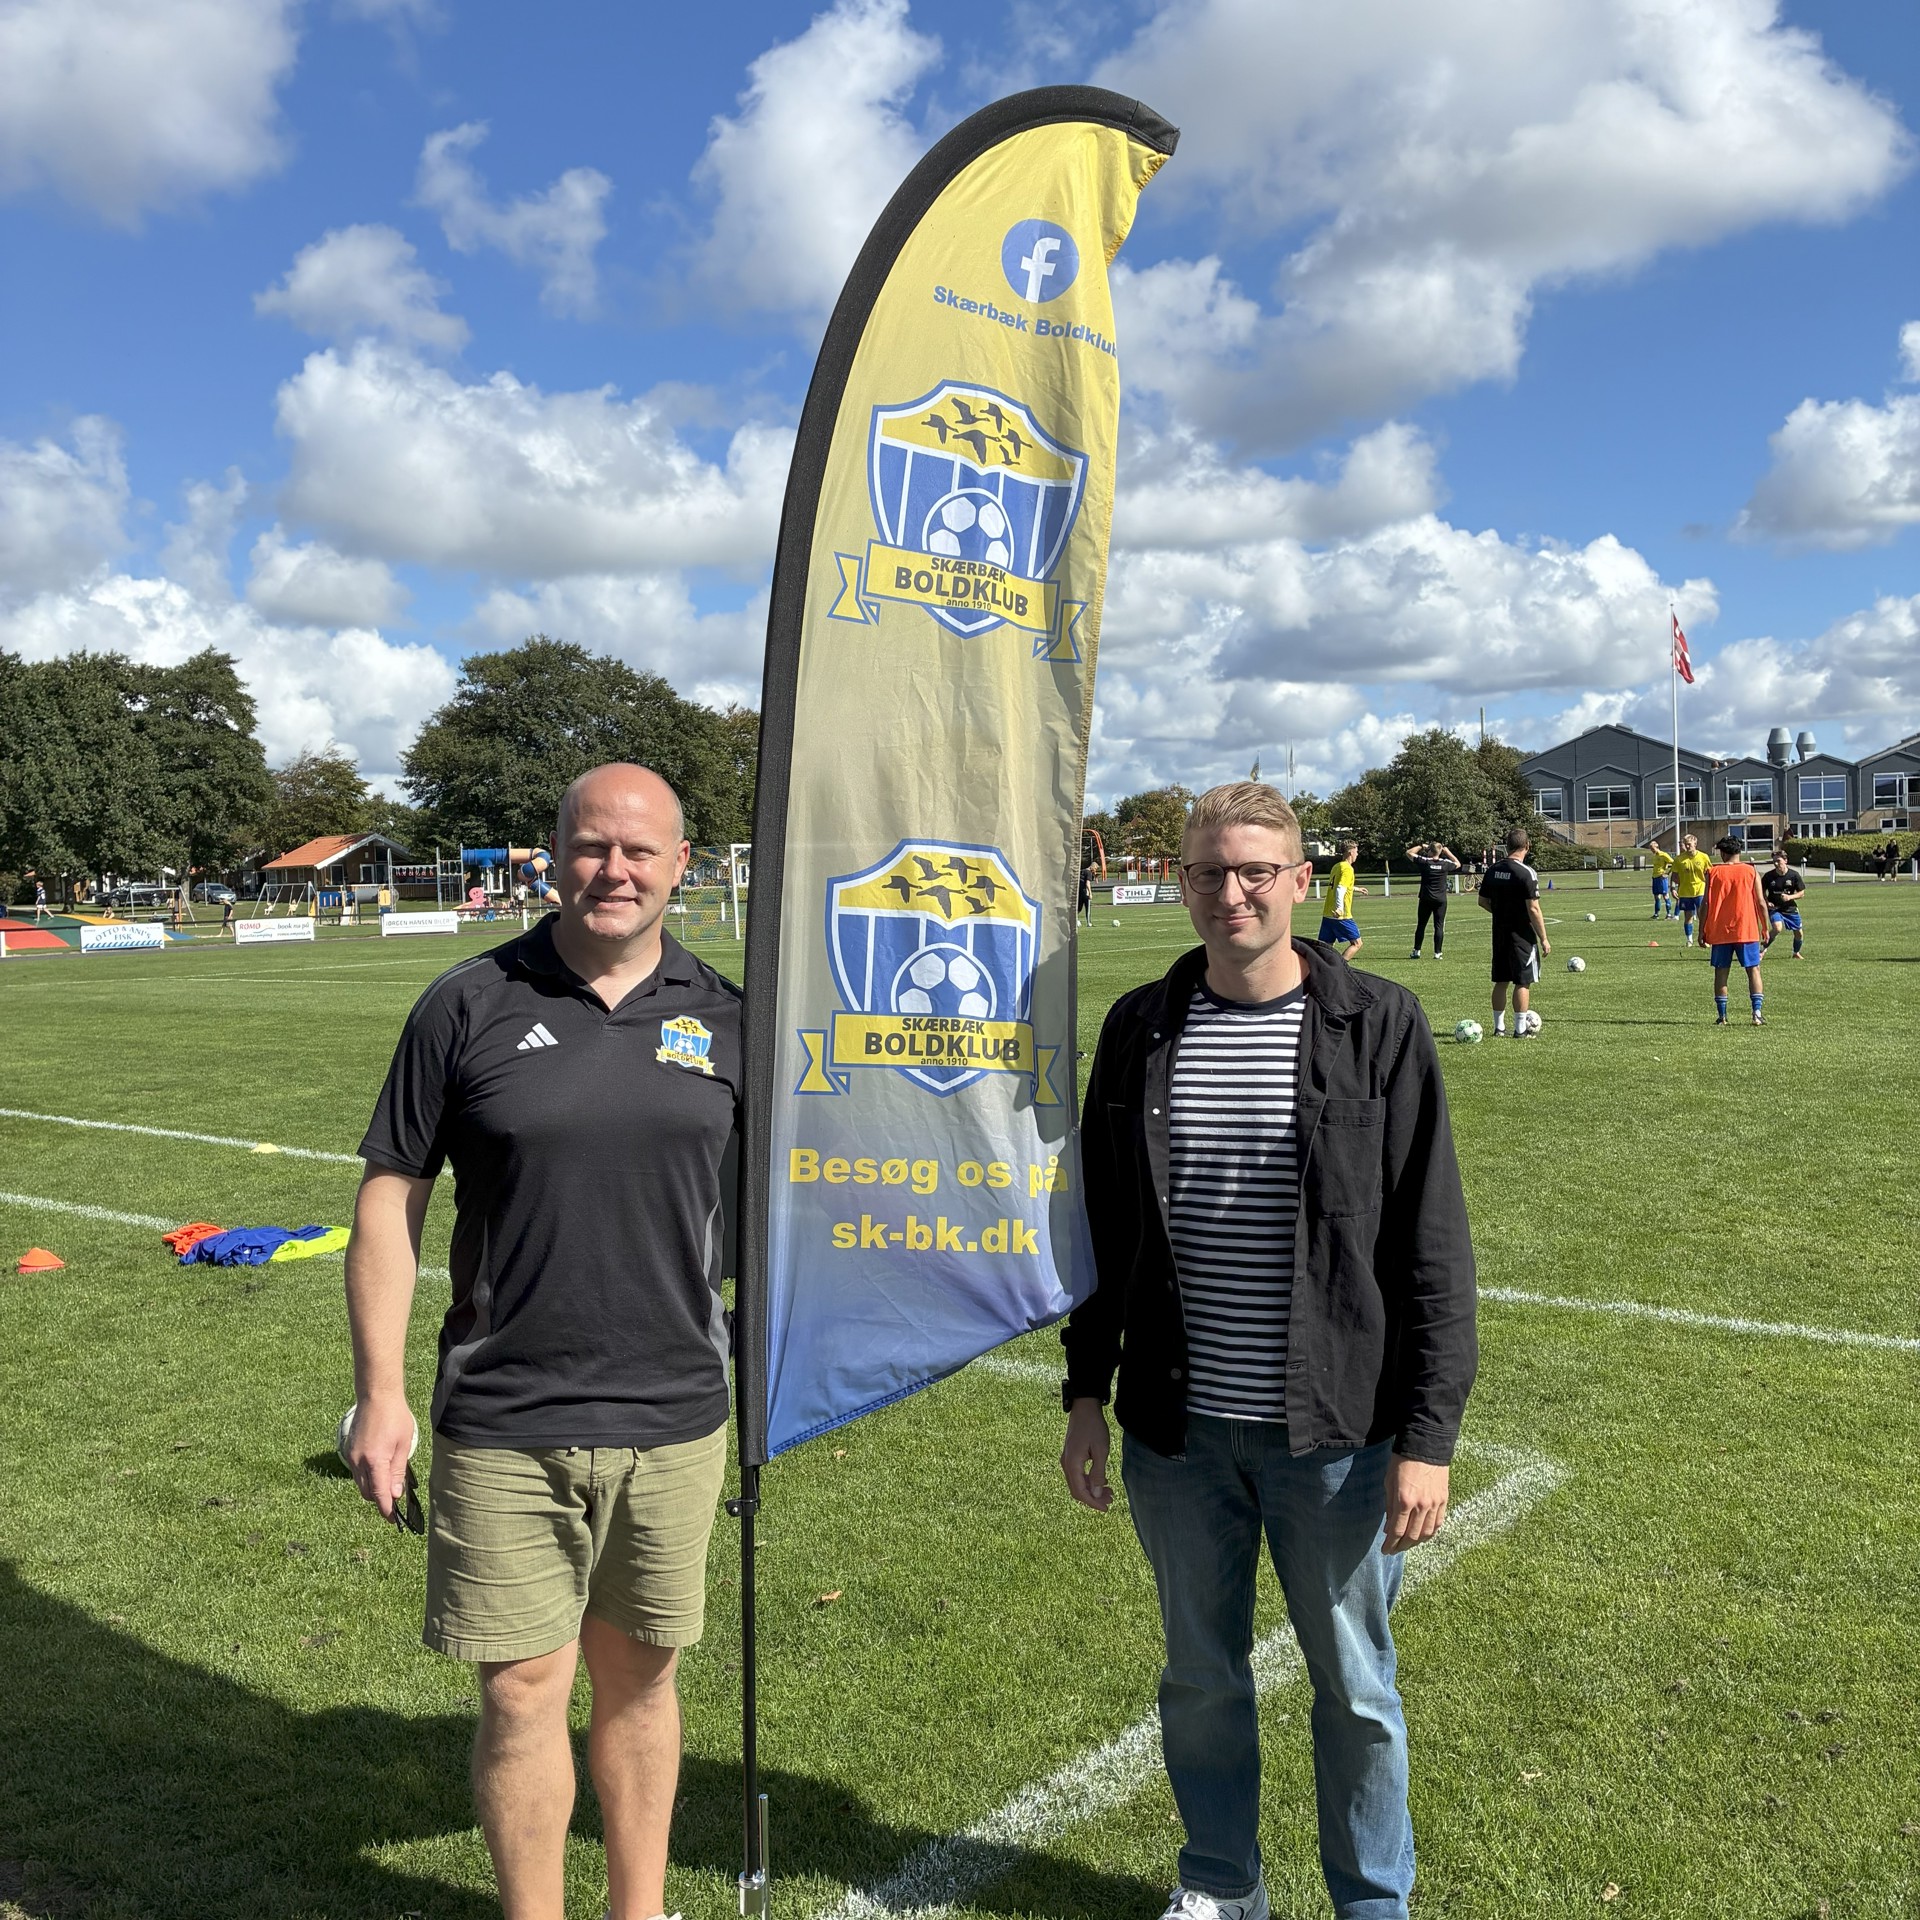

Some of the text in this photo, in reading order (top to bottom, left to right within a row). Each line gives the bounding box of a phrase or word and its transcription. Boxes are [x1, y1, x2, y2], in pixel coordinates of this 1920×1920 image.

[1020, 237, 1061, 303] f
[933, 285, 1029, 332] Skærbæk
[930, 557, 1007, 585] SKÆRBÆK
[894, 566, 1028, 617] BOLDKLUB
[946, 599, 992, 611] anno 1910
[95, 926, 120, 942] OTTO
[114, 933, 132, 941] FISK
[901, 1017, 985, 1036] SKÆRBÆK
[865, 1032, 1020, 1061] BOLDKLUB
[920, 1057, 968, 1066] anno 1910
[789, 1148, 1069, 1198] Besøg os på
[831, 1214, 1040, 1255] sk-bk.dk
